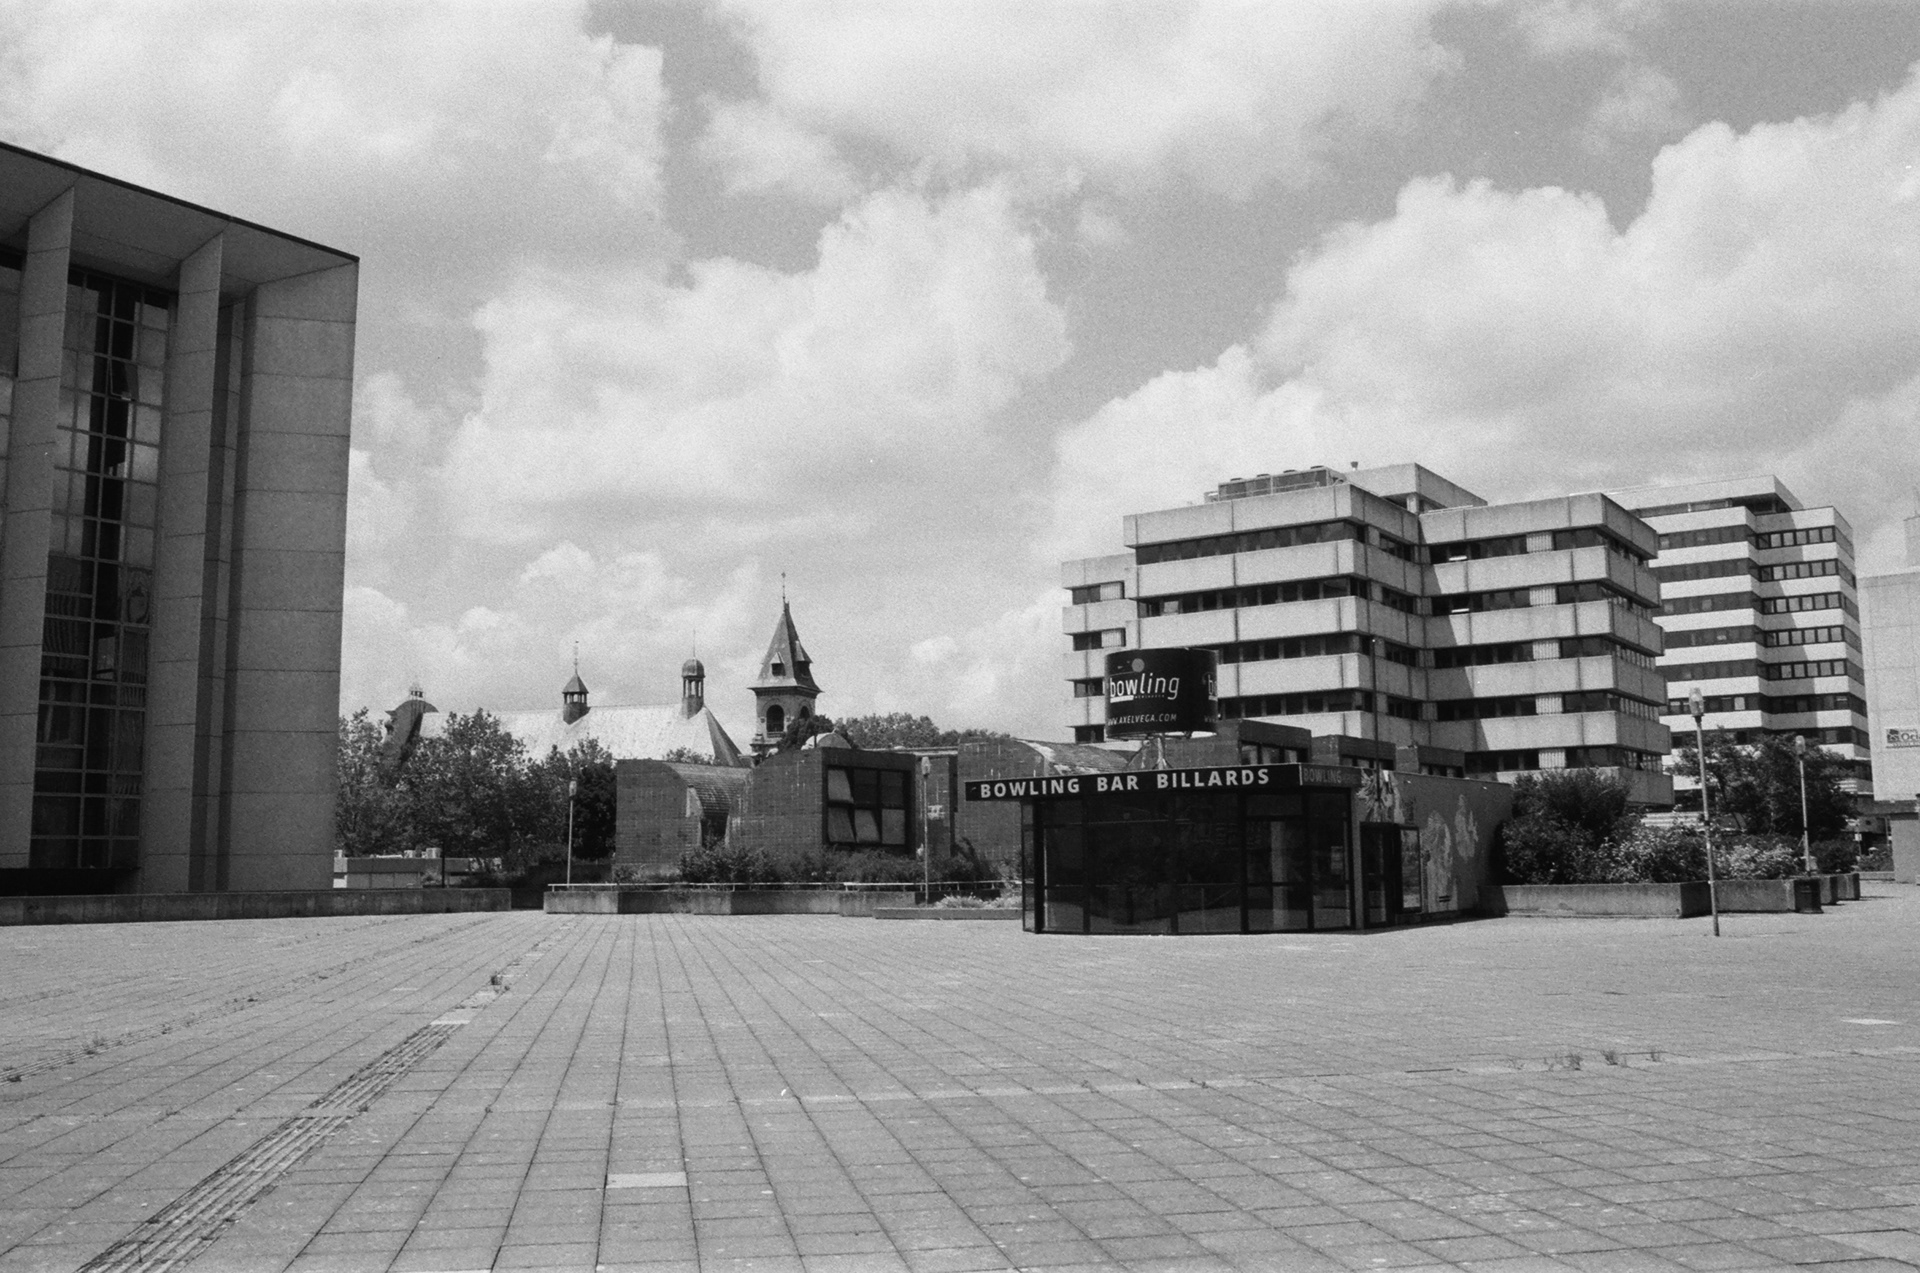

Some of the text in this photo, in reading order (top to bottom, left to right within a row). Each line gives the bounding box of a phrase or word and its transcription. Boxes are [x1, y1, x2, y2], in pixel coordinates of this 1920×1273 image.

[1109, 672, 1180, 701] bowling
[980, 768, 1270, 799] BOWLING BAR BILLARDS
[1303, 767, 1342, 784] BOWLING
